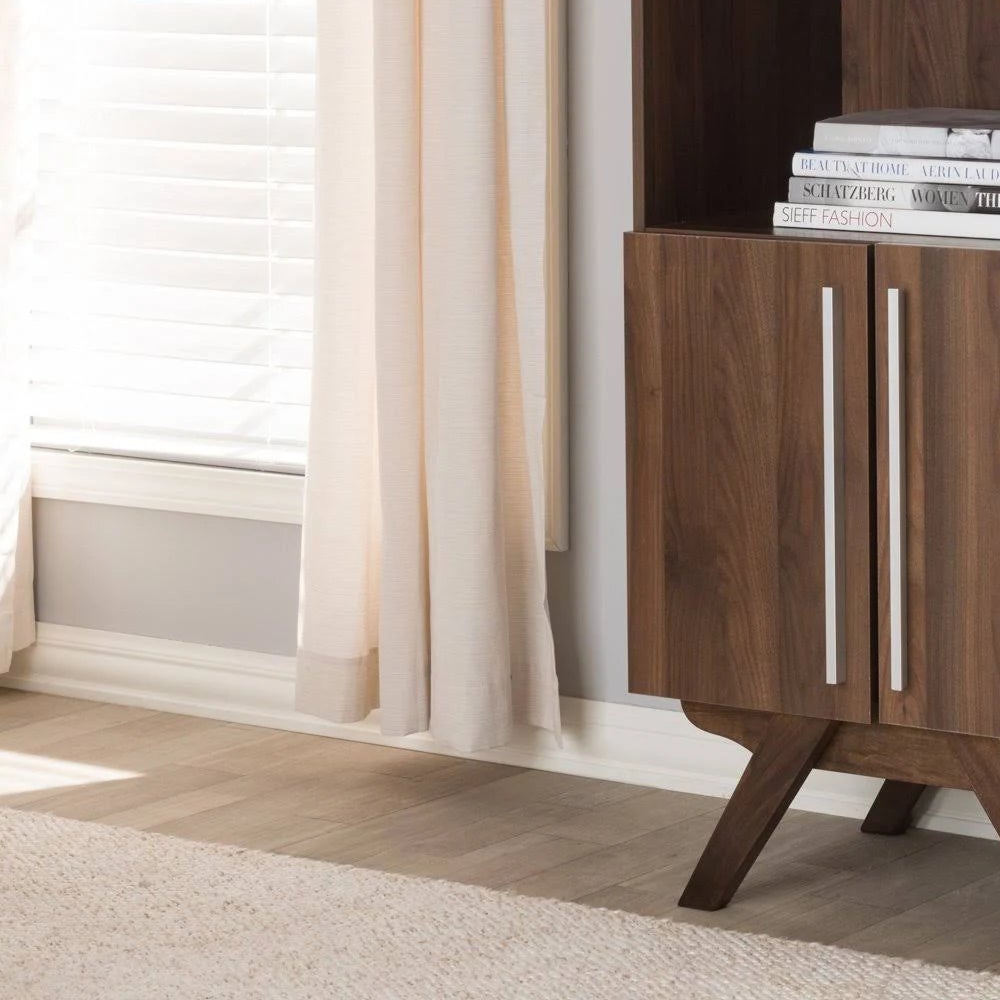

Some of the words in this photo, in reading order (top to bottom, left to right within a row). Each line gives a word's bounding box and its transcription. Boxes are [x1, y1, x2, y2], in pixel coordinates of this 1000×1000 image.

[801, 159, 849, 172] BEAUTY
[870, 162, 909, 176] HOME
[921, 165, 961, 179] AERIN
[803, 182, 895, 201] SCHATZBERG
[911, 189, 968, 206] WOMEN
[782, 206, 818, 223] SIEFF
[822, 208, 893, 228] FASHION
